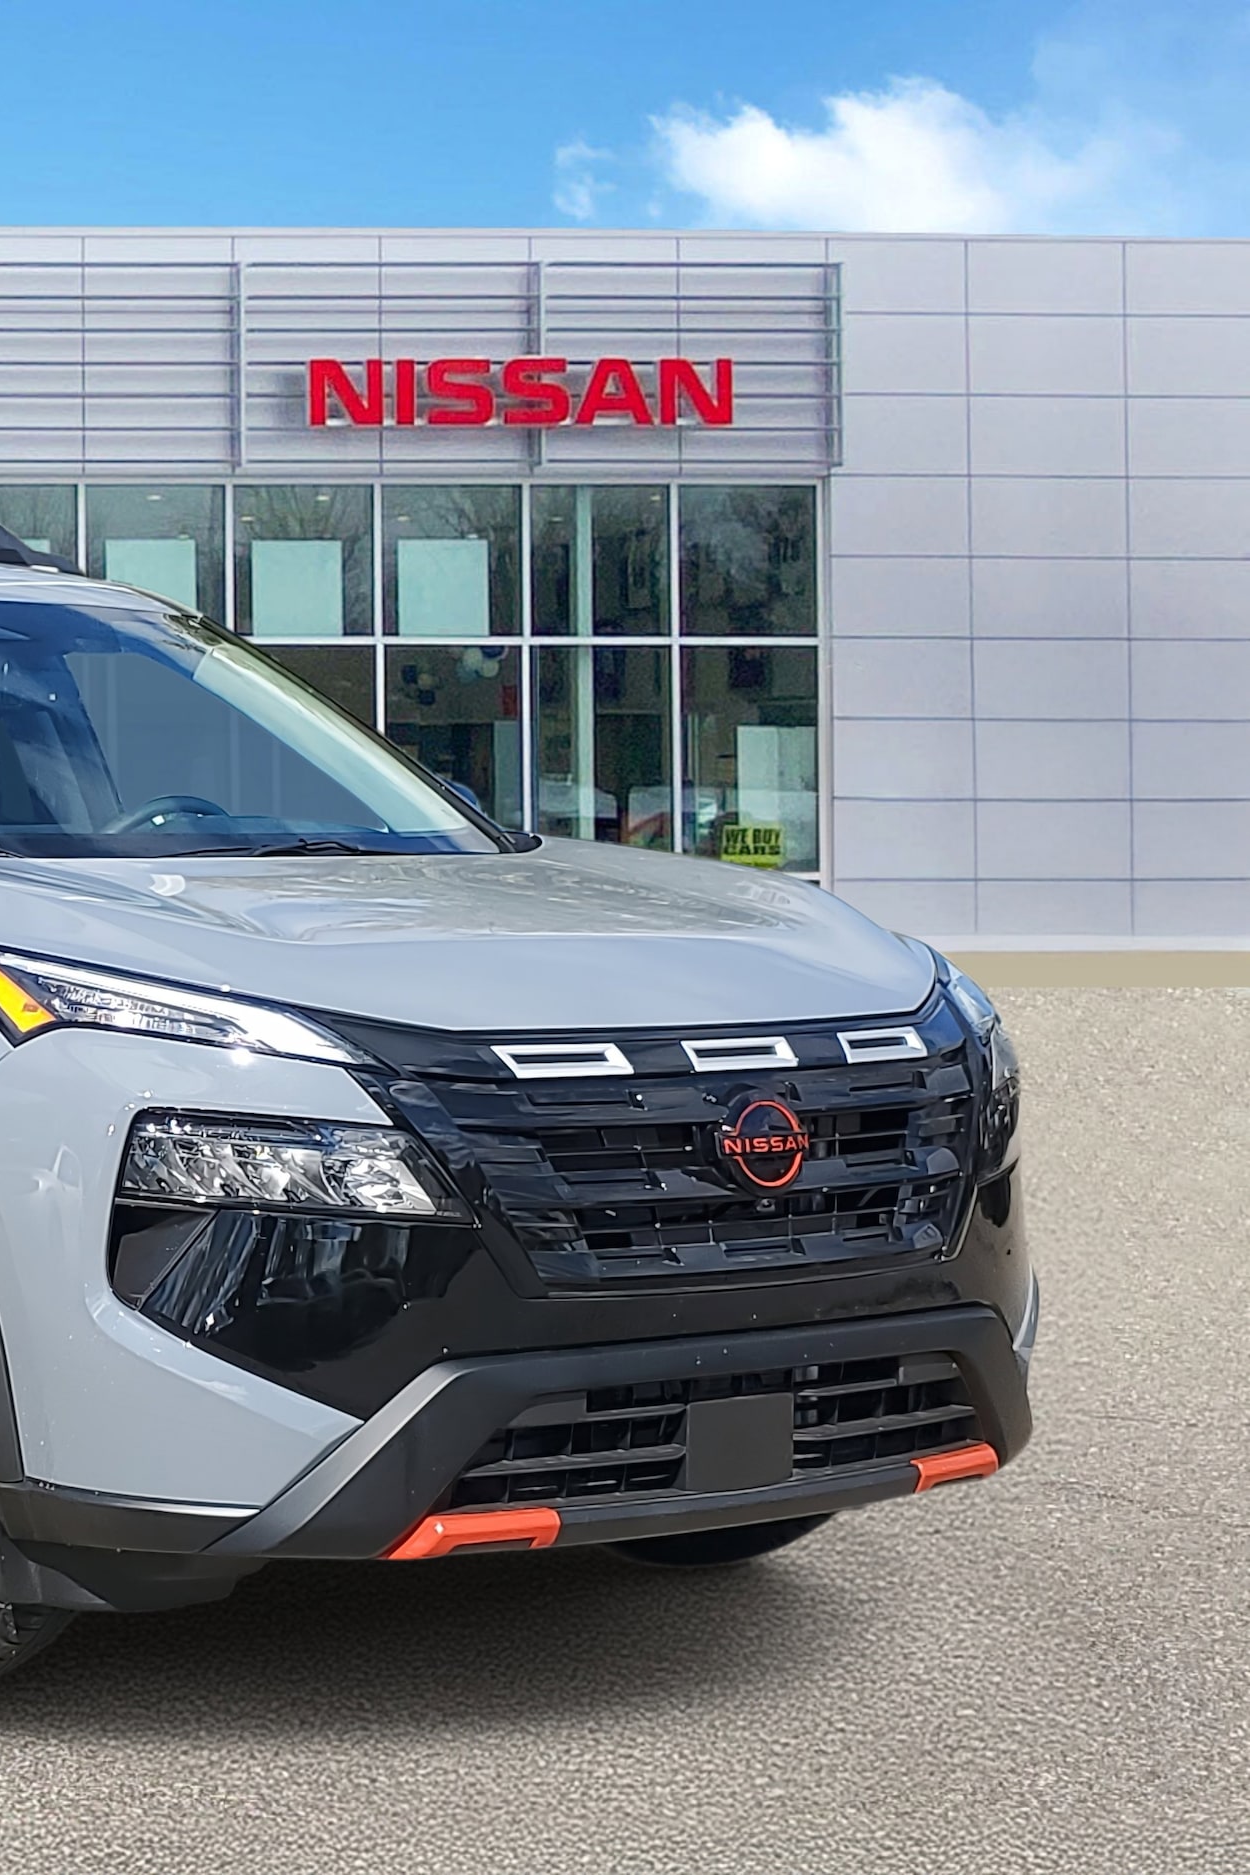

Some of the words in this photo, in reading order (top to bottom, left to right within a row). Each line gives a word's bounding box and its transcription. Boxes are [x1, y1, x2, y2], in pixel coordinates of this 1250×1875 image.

[308, 358, 734, 426] NISSAN
[725, 828, 748, 845] WE
[753, 828, 781, 845] BUY
[723, 1134, 809, 1154] NISSAN
